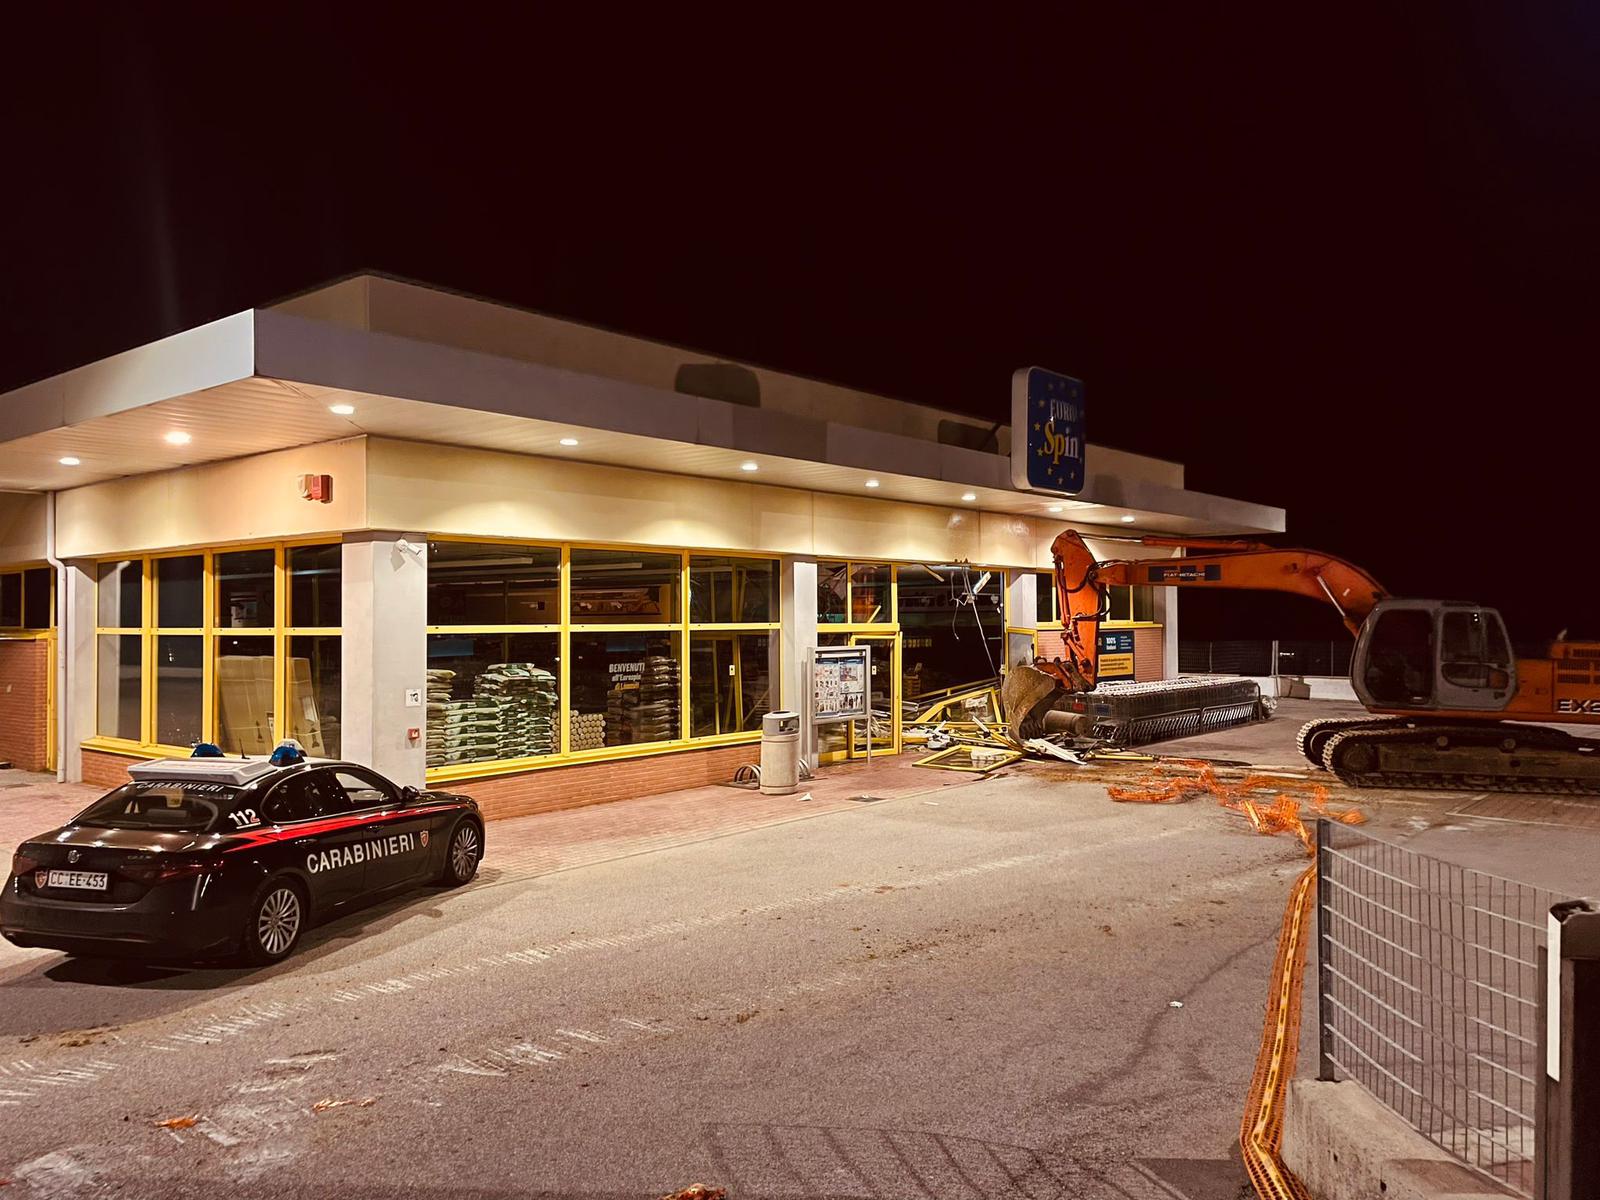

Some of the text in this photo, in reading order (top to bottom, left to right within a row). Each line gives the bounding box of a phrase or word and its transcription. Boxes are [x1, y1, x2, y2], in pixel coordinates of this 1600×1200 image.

[1050, 399, 1078, 421] EURO
[1044, 419, 1079, 464] Spin
[609, 663, 645, 673] BENVENUTI
[136, 782, 224, 793] CARABINIERI
[228, 808, 259, 826] 112
[307, 833, 415, 874] CARABINIERI
